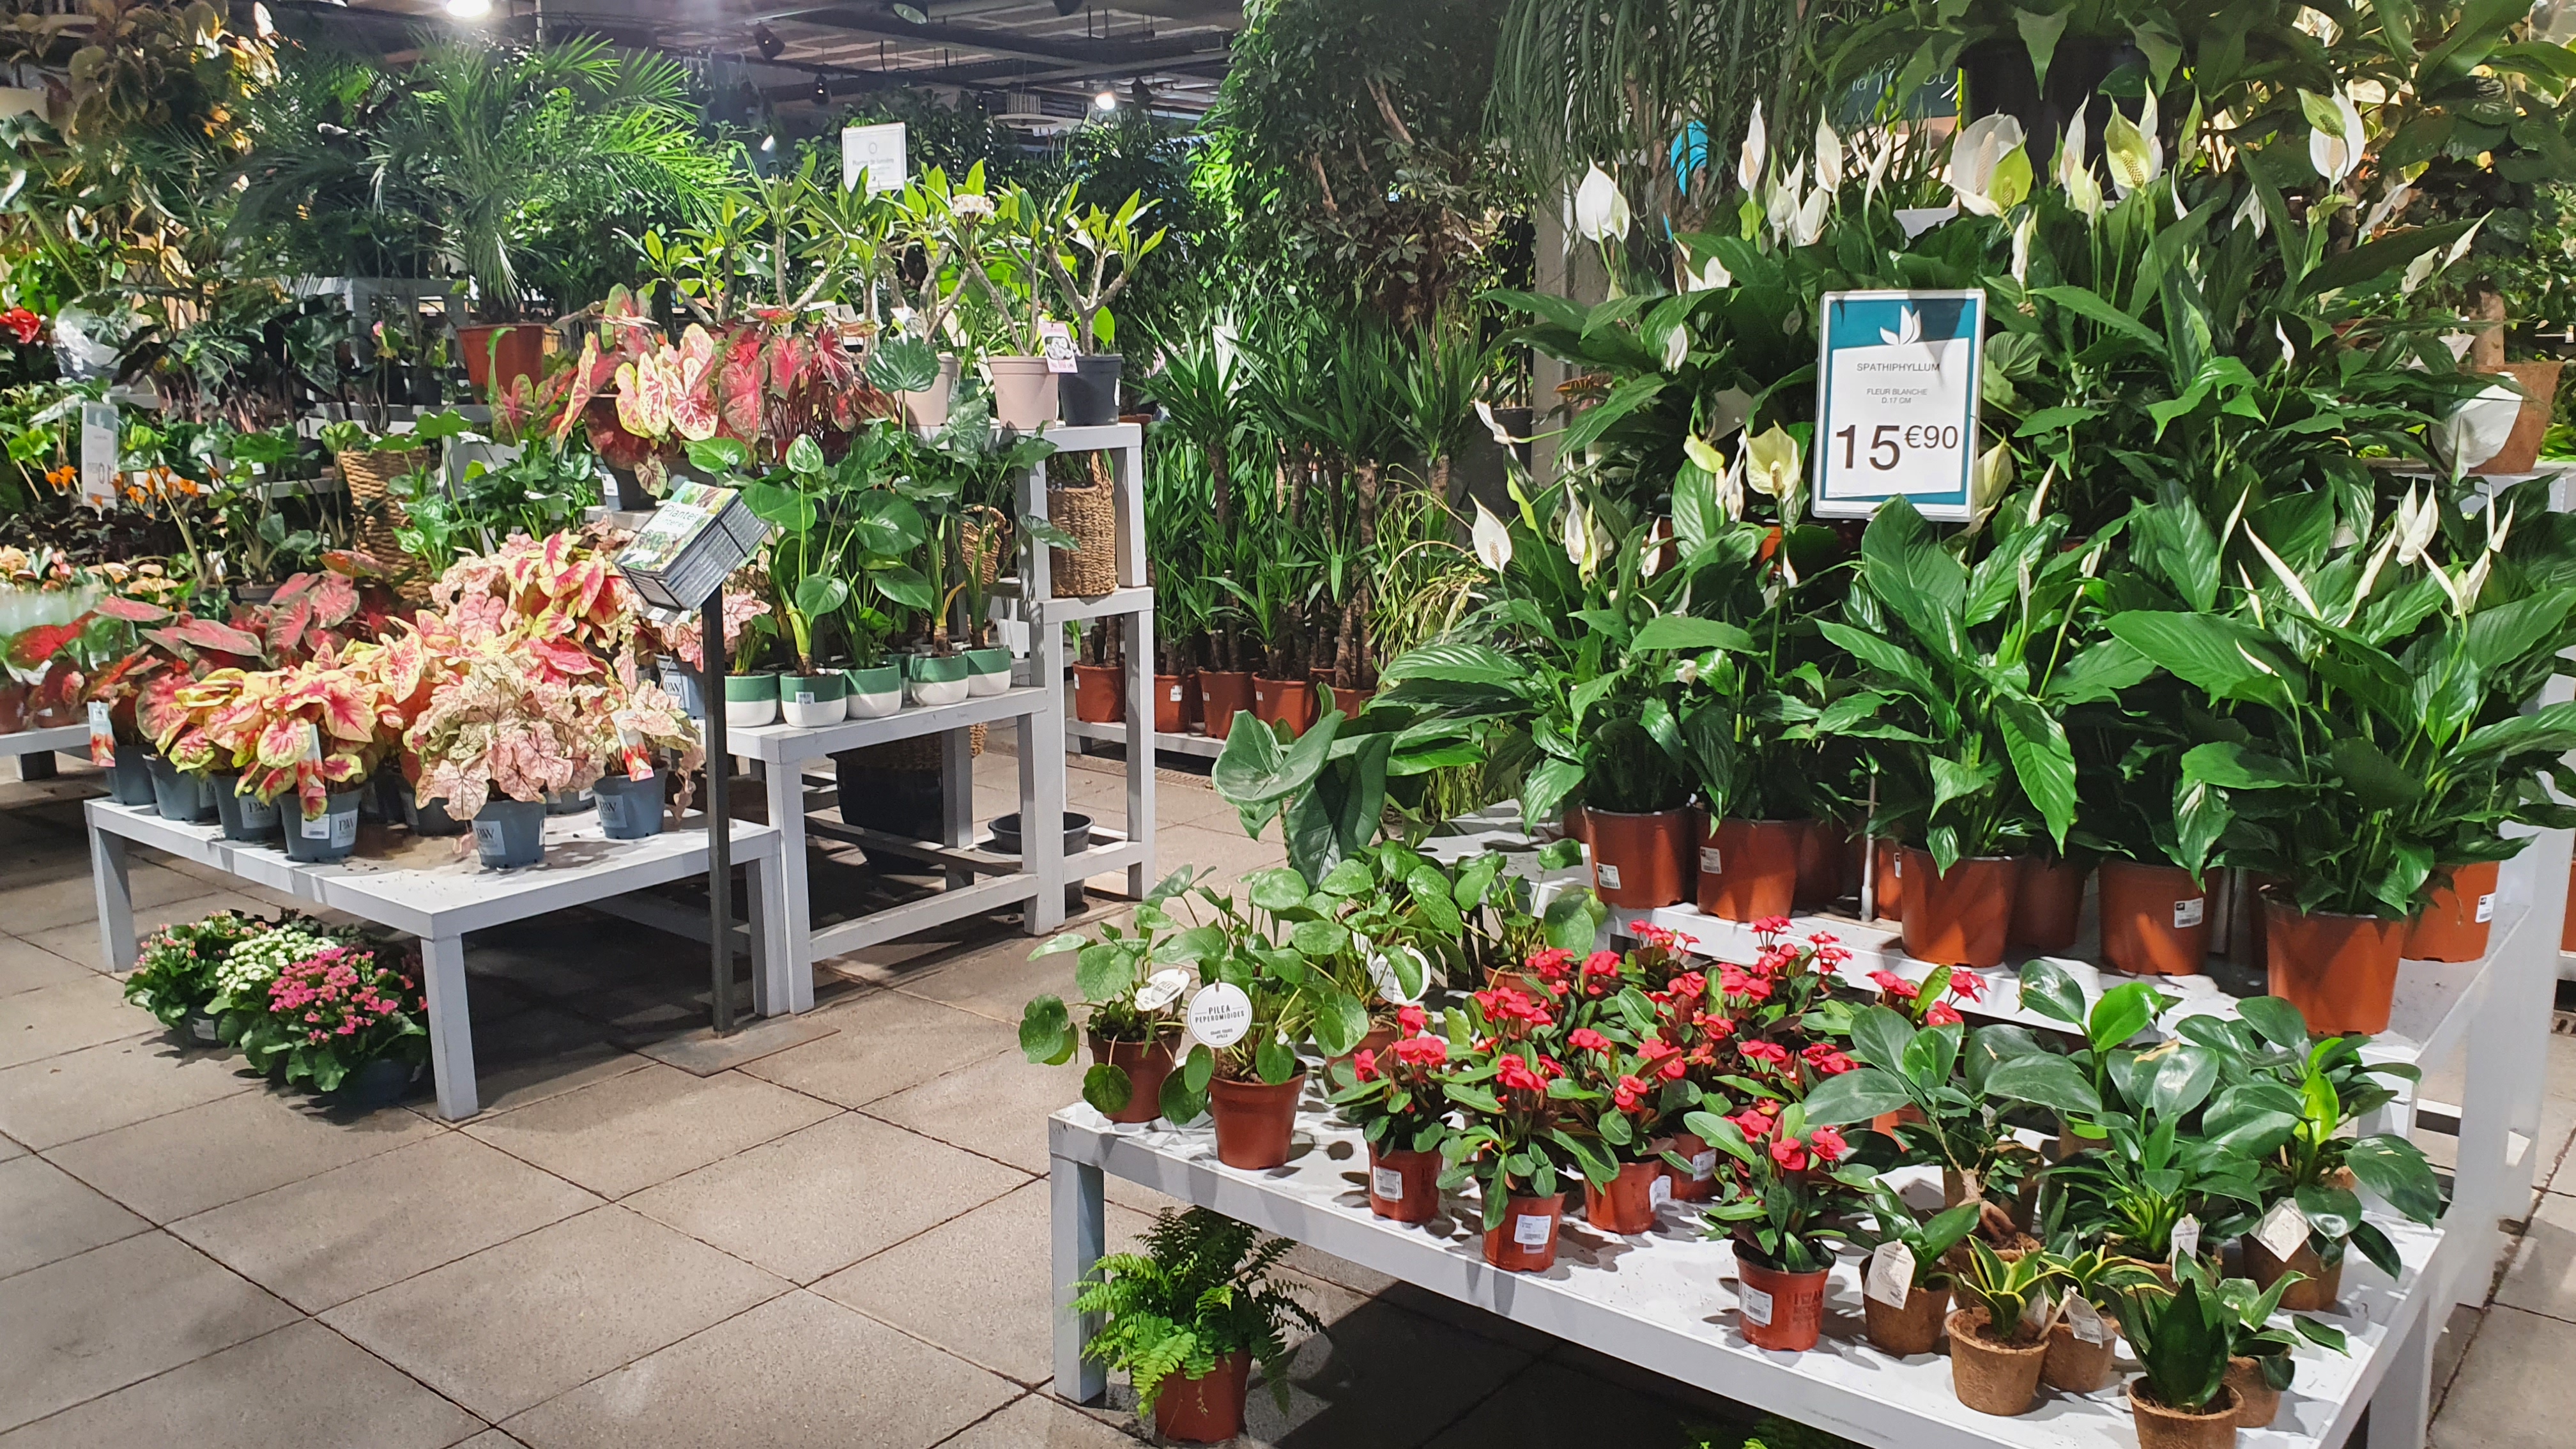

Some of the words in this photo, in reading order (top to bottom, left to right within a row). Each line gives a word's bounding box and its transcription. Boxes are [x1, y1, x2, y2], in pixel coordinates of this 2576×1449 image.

[1856, 363, 1940, 372] SPATHIPHYLLUM
[1209, 1004, 1230, 1015] PILEA
[1195, 1010, 1245, 1023] PEPEROMIOIDES
